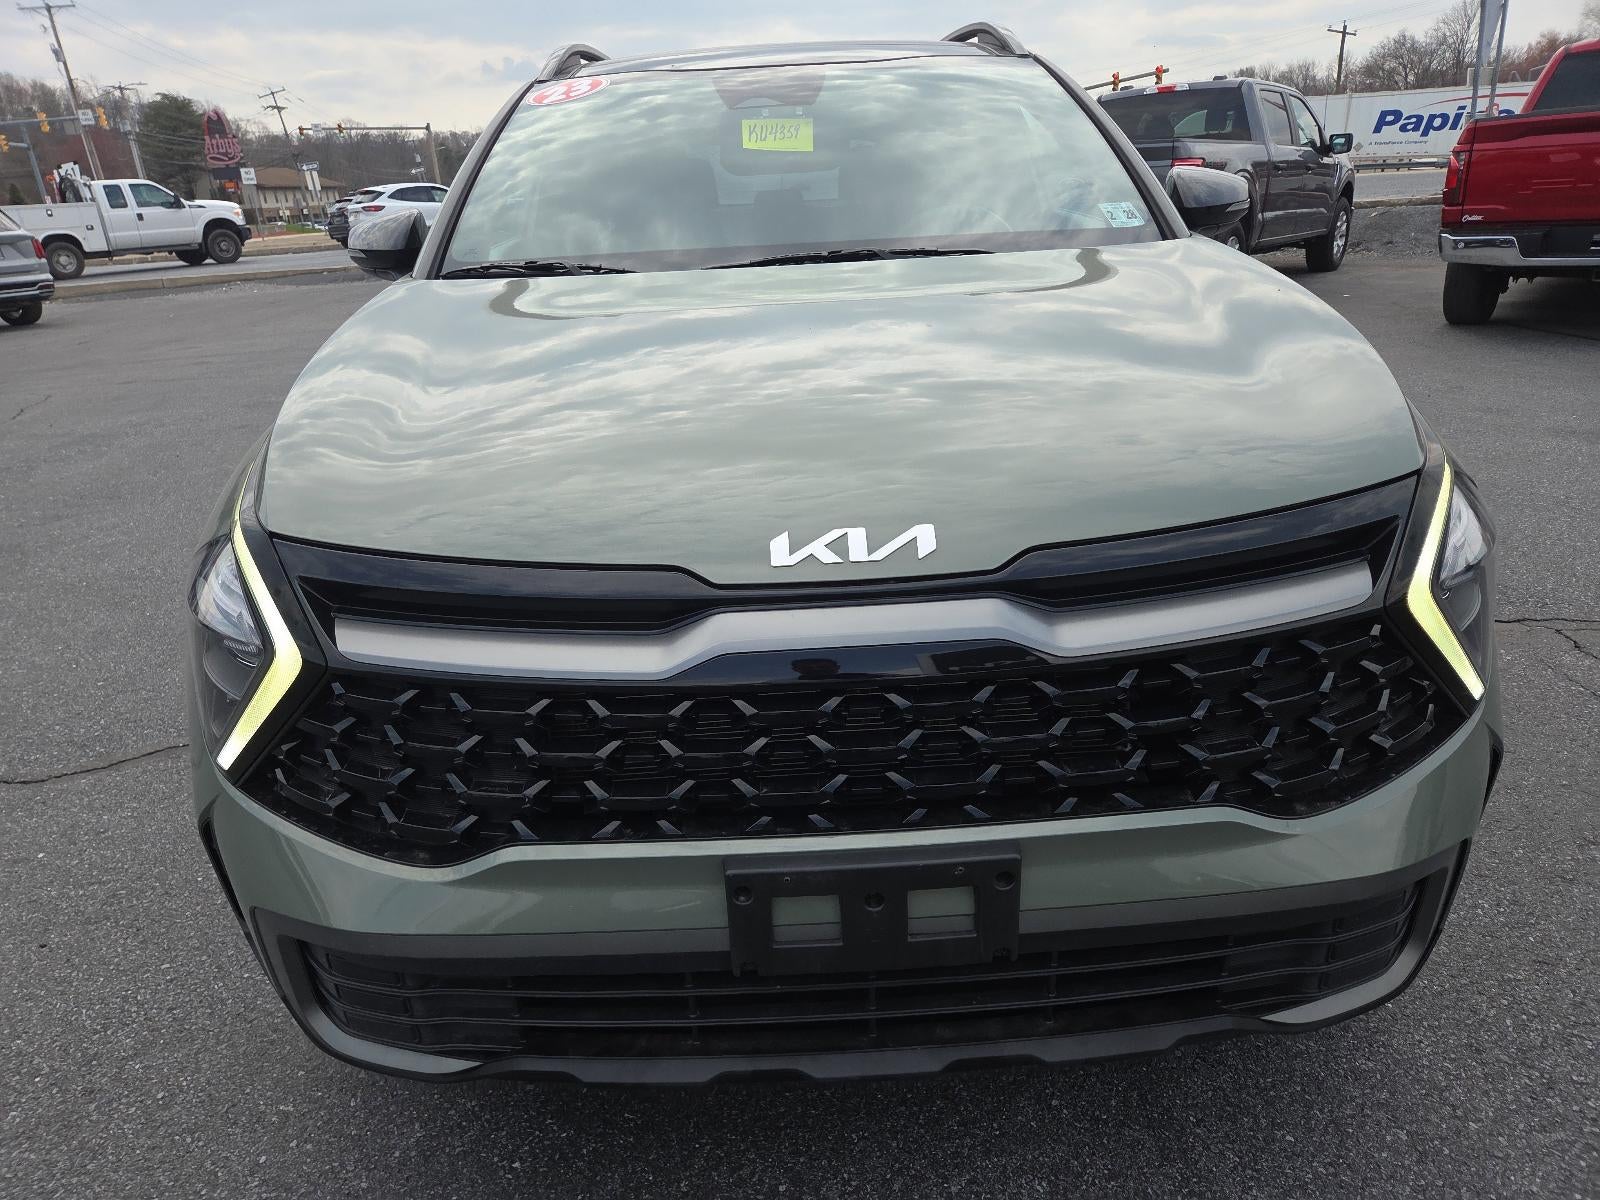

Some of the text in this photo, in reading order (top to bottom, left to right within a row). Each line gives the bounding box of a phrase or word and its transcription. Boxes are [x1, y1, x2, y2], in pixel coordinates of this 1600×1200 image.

[542, 79, 593, 104] 23
[204, 135, 242, 157] Arby's
[1106, 210, 1117, 220] 2
[769, 523, 937, 567] KIA
